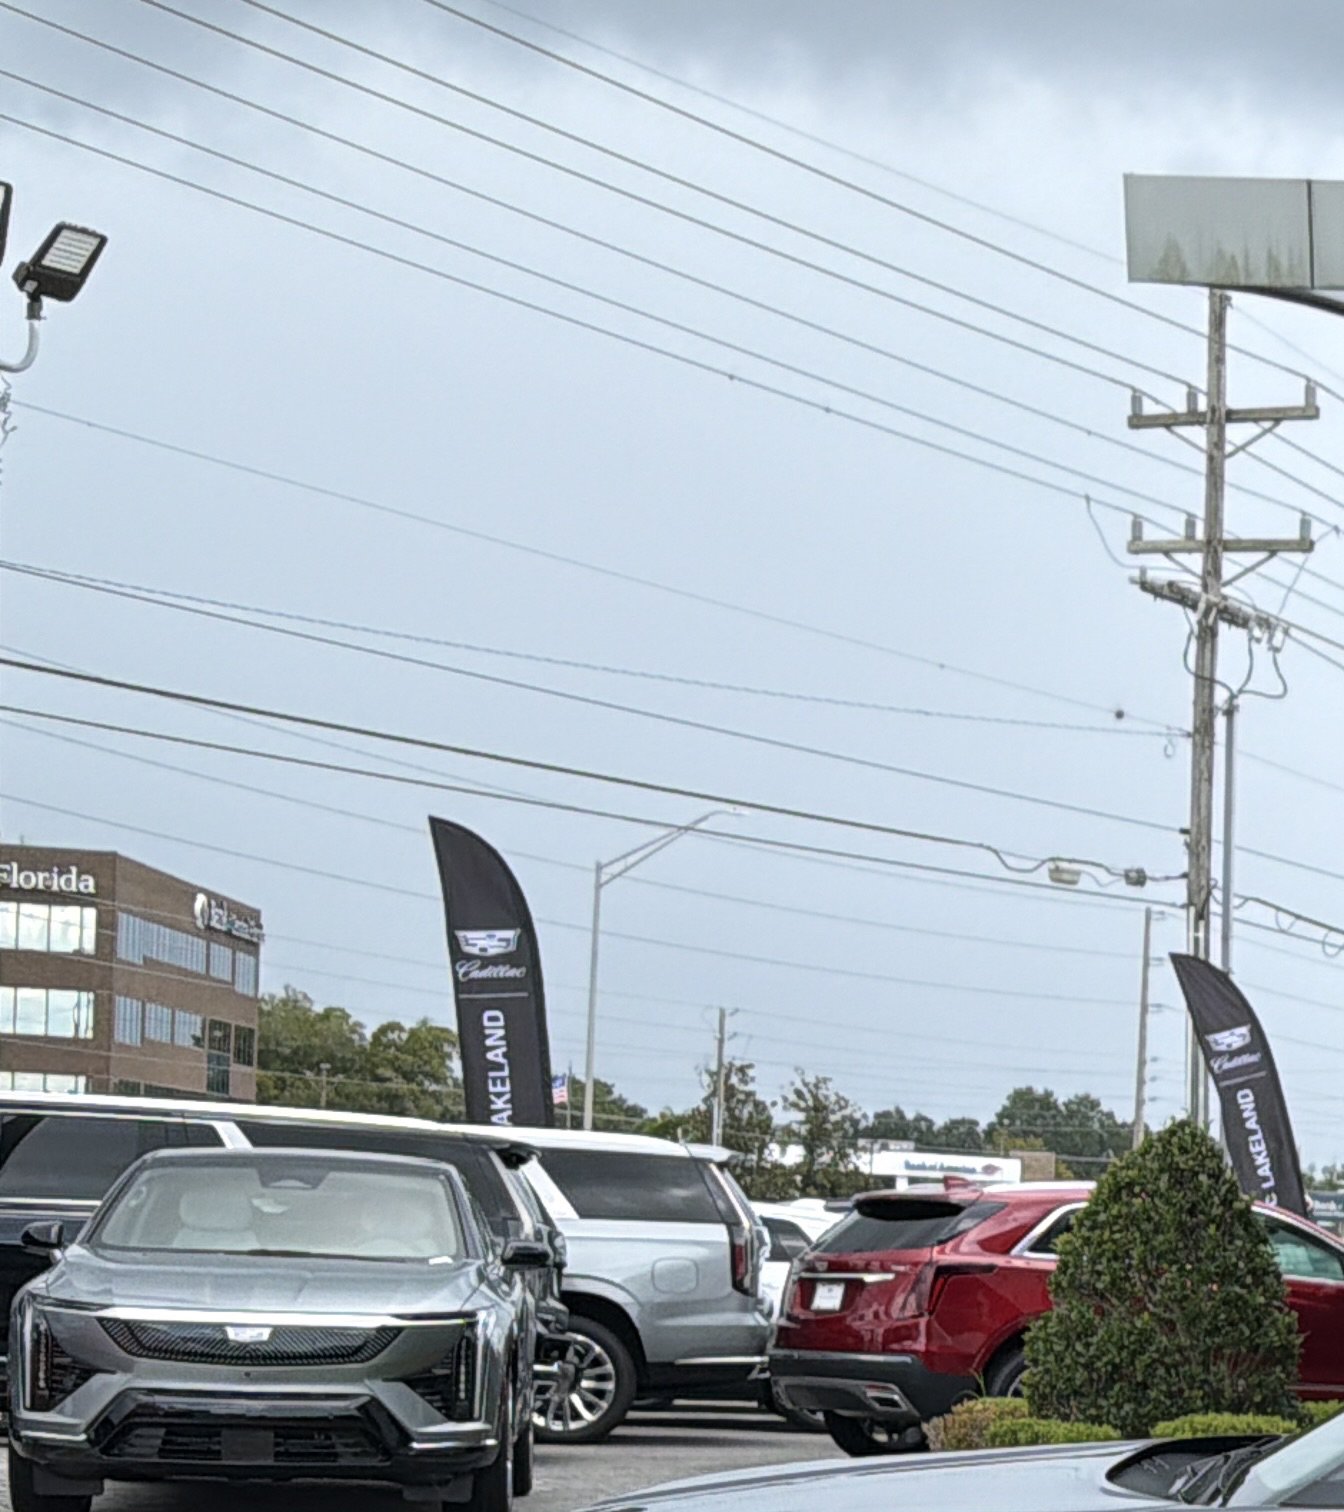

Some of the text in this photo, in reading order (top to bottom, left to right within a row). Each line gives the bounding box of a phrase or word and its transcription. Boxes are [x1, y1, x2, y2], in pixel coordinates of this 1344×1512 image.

[455, 959, 527, 982] Cadillac
[482, 1009, 513, 1126] AKELAND
[1210, 1052, 1262, 1075] Cadillac
[1236, 1087, 1276, 1189] LAKELAND
